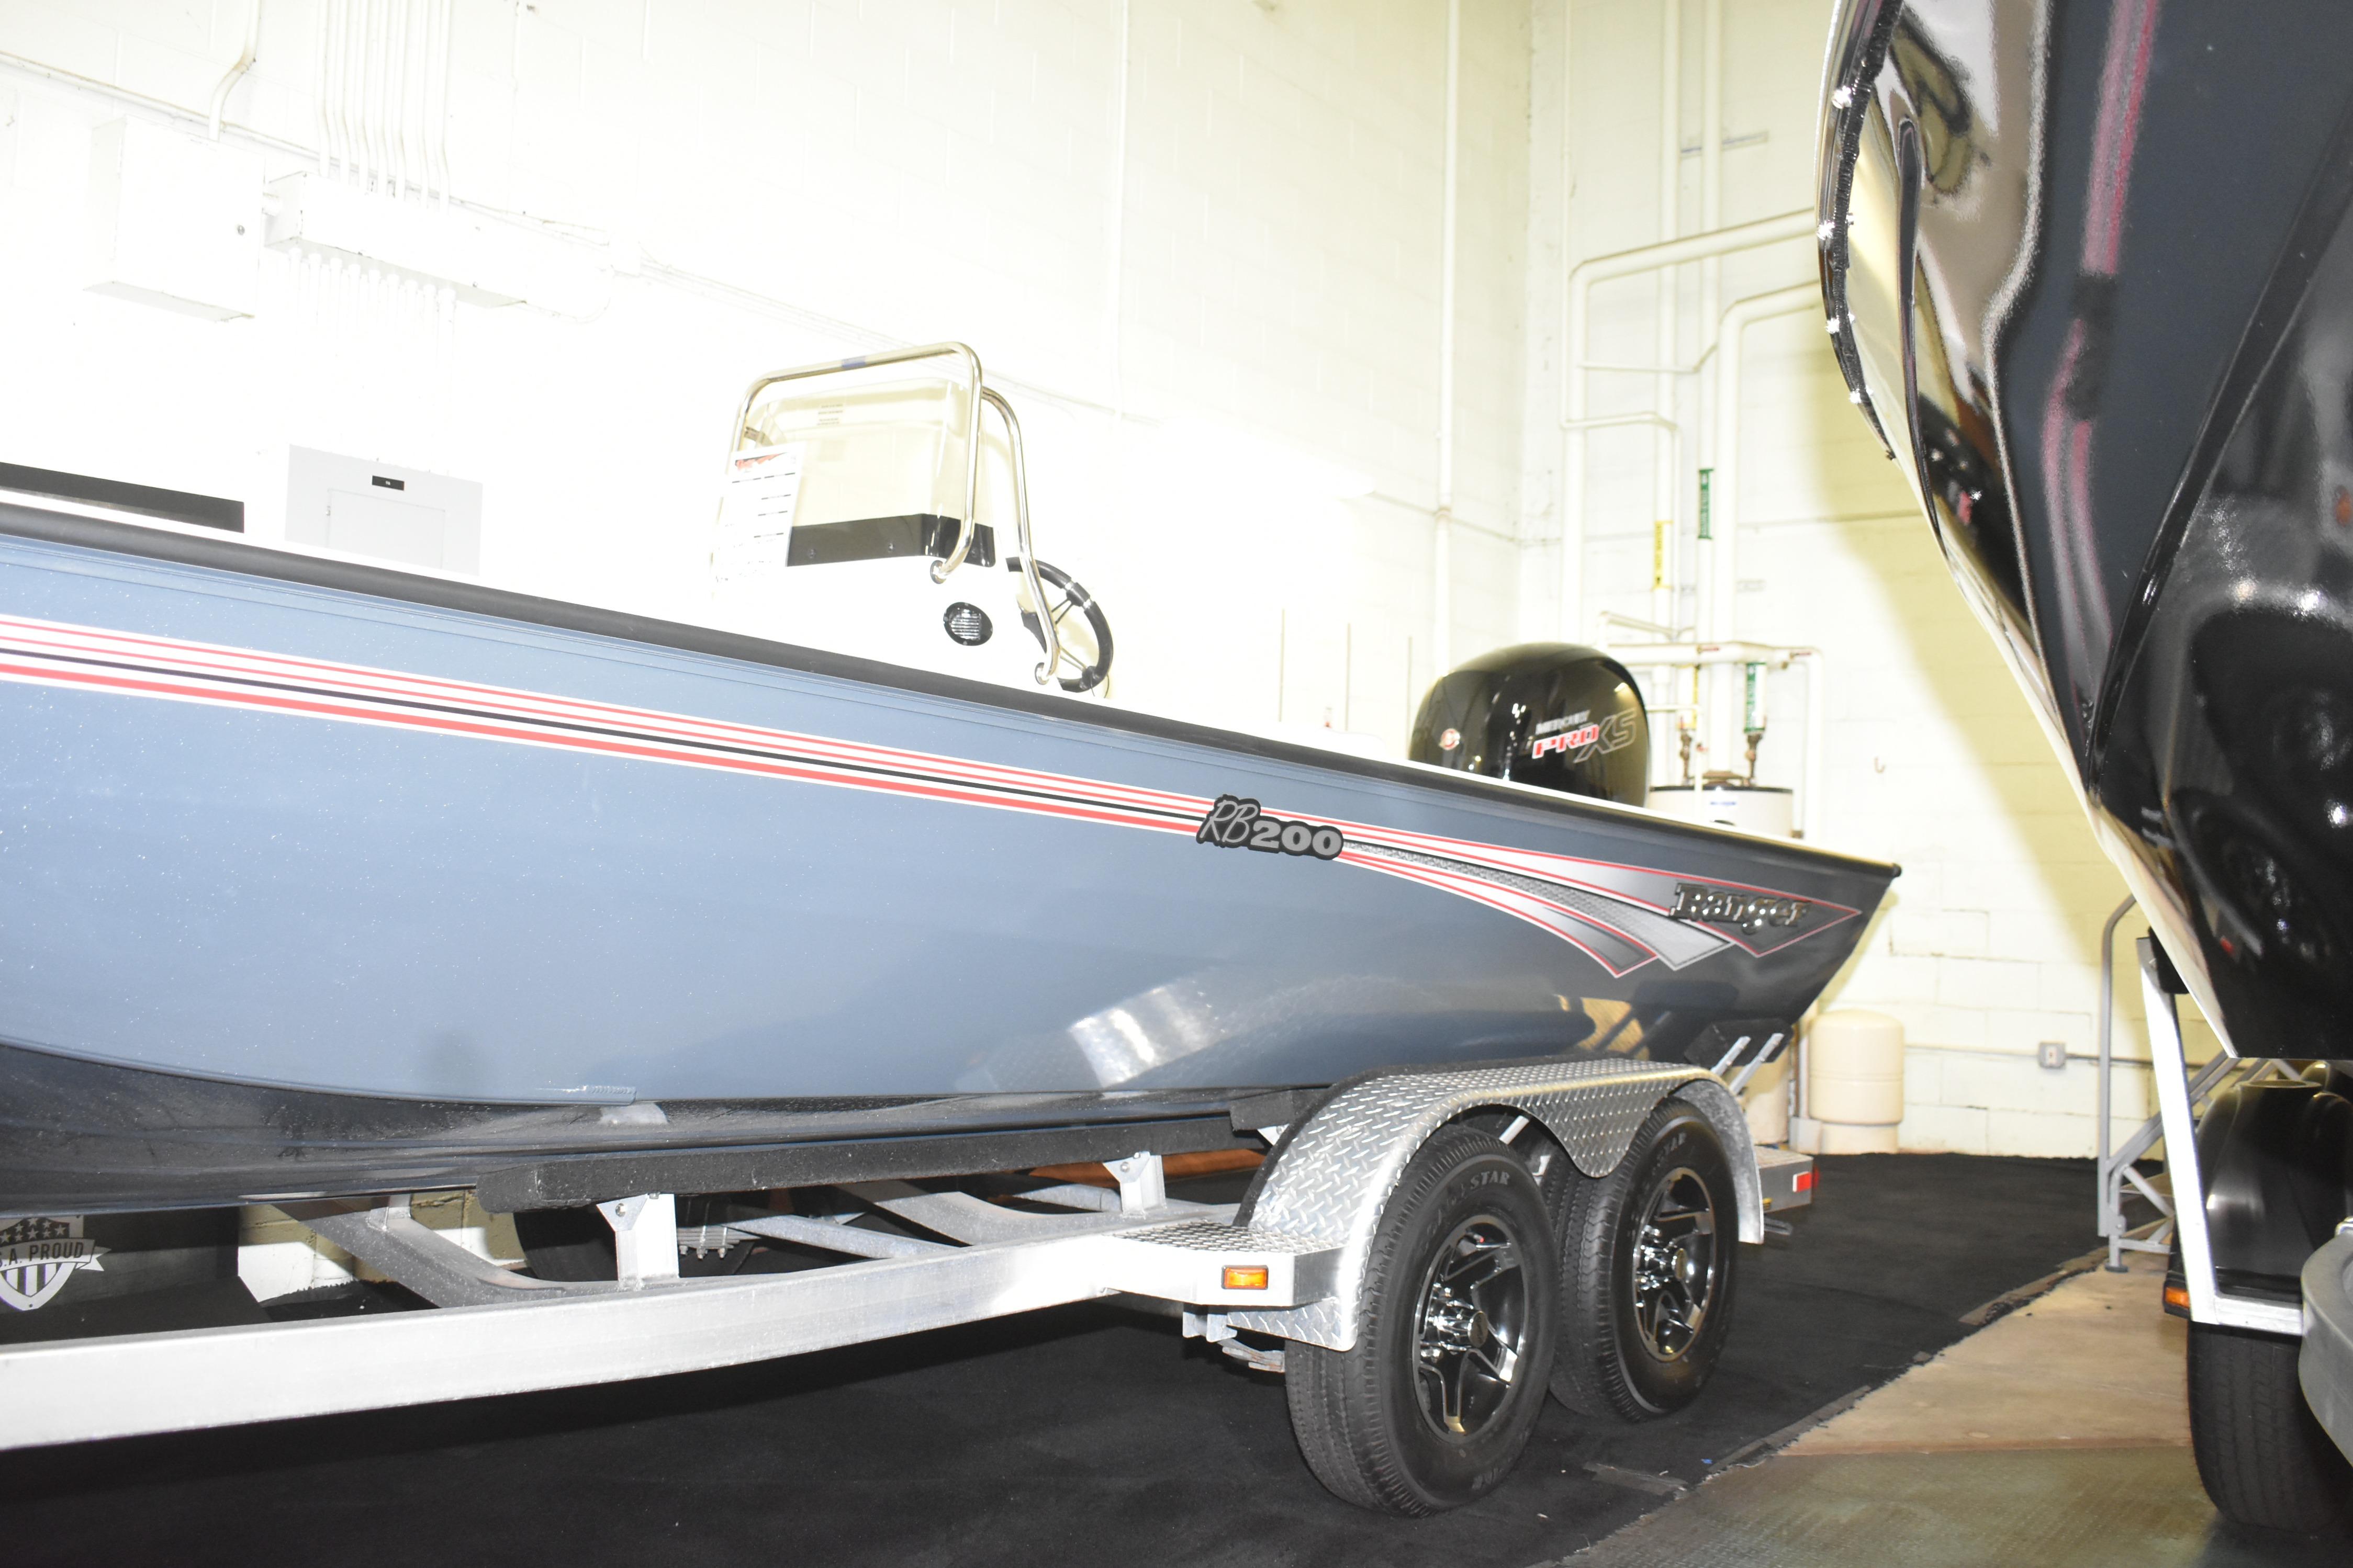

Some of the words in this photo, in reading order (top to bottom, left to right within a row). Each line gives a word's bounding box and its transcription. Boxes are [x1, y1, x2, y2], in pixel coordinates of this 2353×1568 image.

[1532, 724, 1599, 759] PRO
[1573, 707, 1638, 764] XS
[1197, 797, 1343, 858] RB200
[1668, 882, 1812, 934] Ranger
[29, 1242, 84, 1262] PROUD
